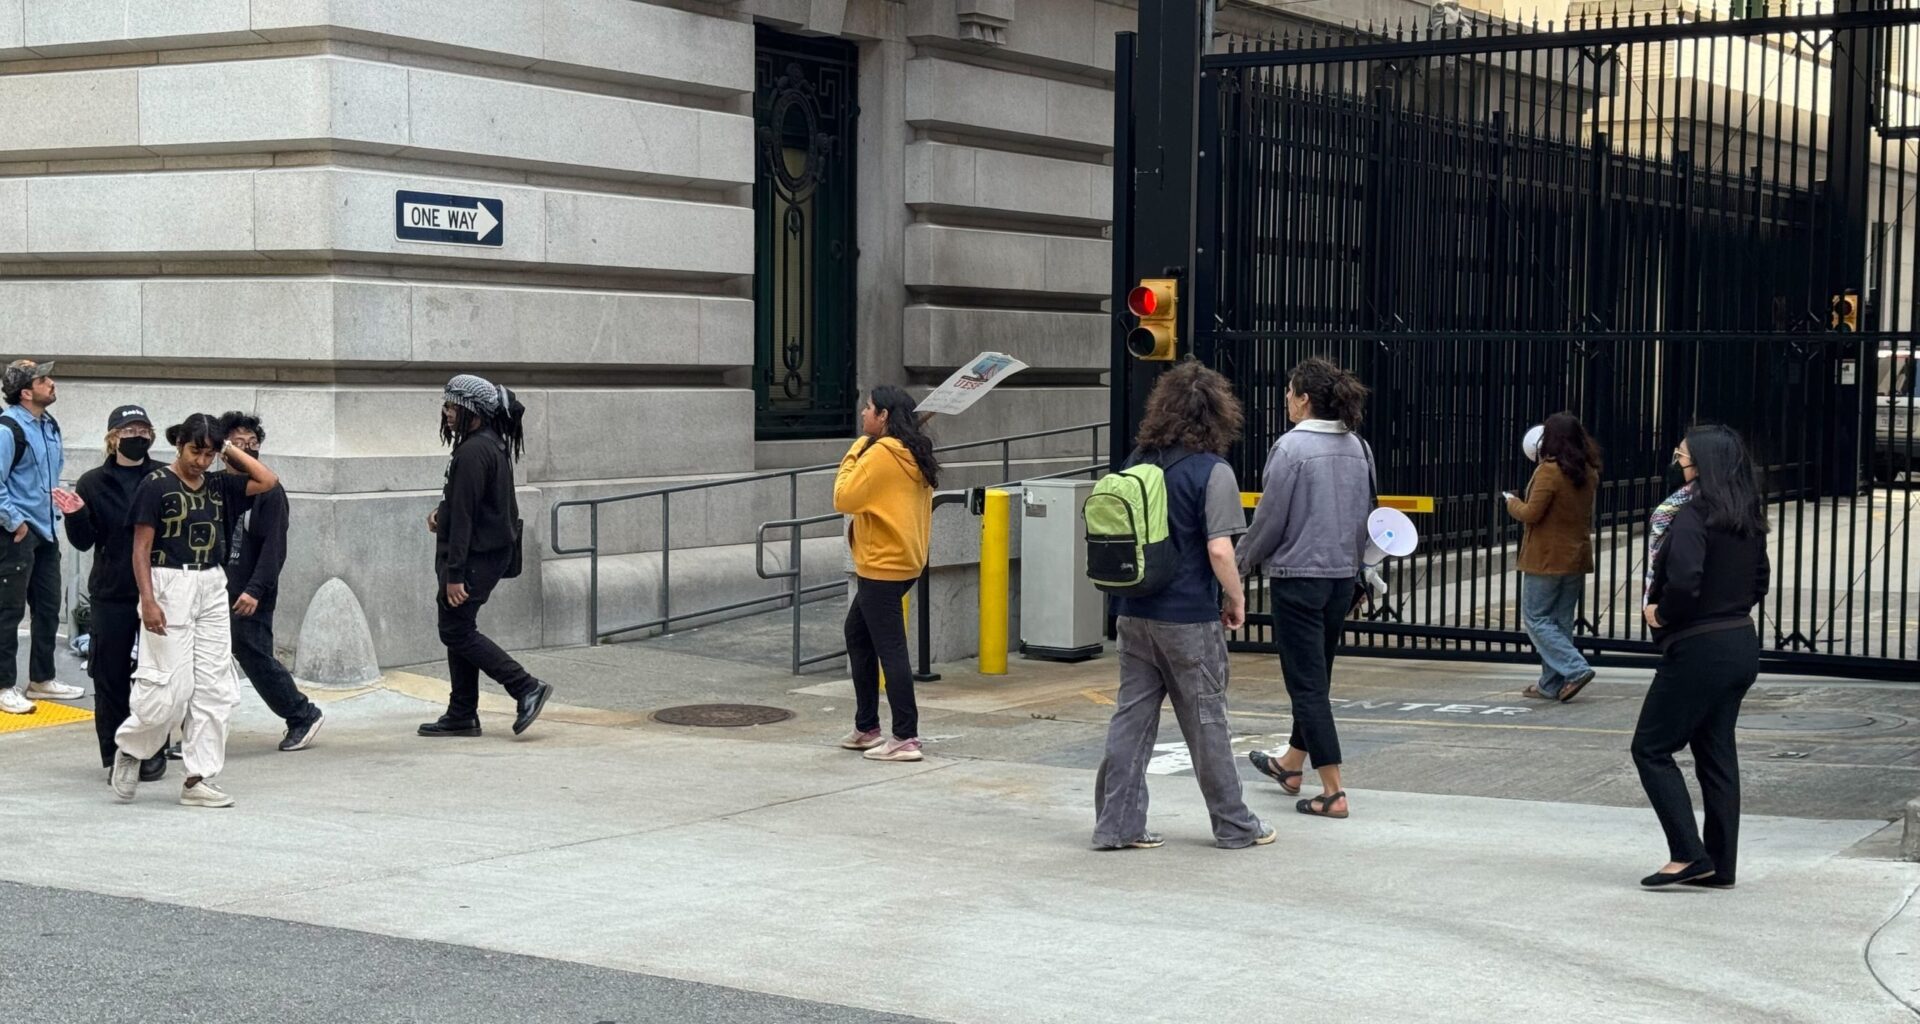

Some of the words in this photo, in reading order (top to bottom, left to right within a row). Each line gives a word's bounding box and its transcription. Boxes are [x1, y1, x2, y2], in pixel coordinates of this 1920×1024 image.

[411, 206, 440, 227] ONE
[448, 210, 477, 230] WAY
[1329, 698, 1532, 716] NTER
